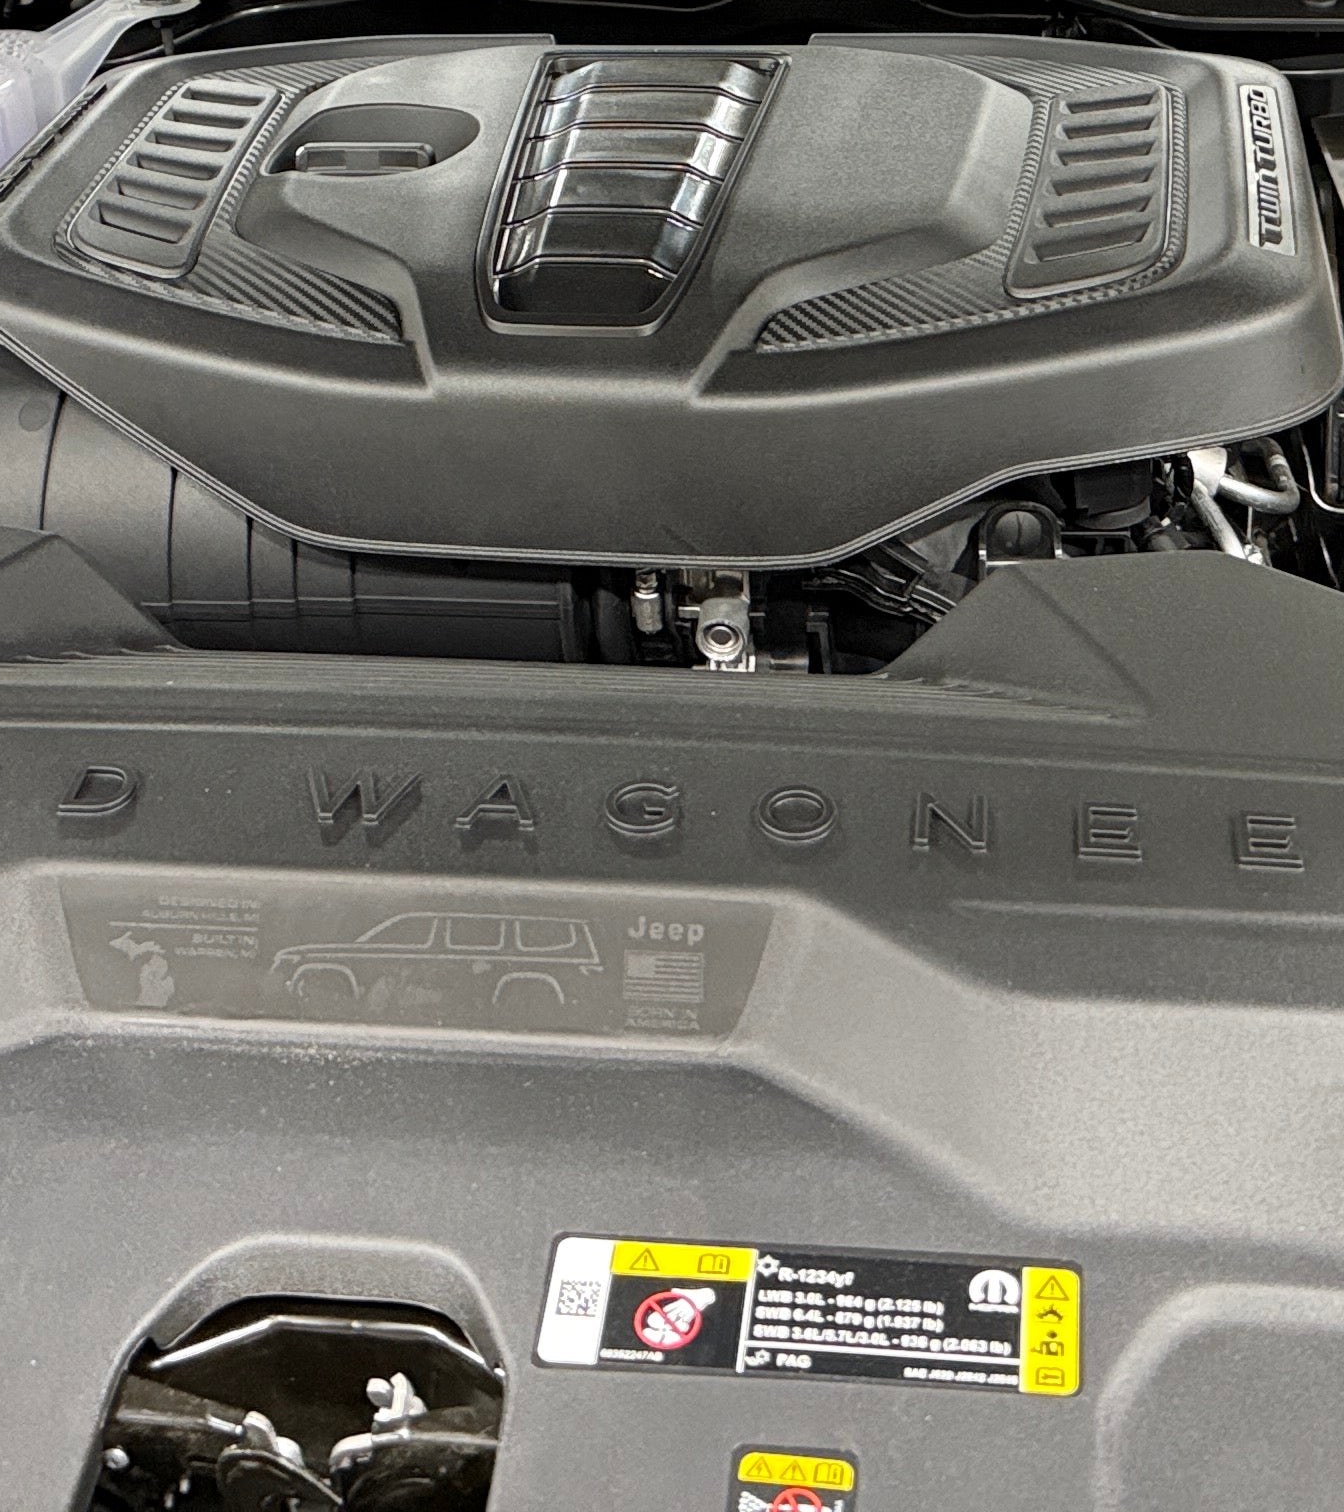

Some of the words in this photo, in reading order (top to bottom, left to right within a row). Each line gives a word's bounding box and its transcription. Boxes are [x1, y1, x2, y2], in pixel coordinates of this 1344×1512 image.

[1247, 86, 1275, 172] TURBO
[627, 916, 705, 947] Jeep
[778, 1267, 855, 1289] R-1234yf
[758, 1289, 793, 1303] LWB
[776, 1354, 812, 1370] PAG
